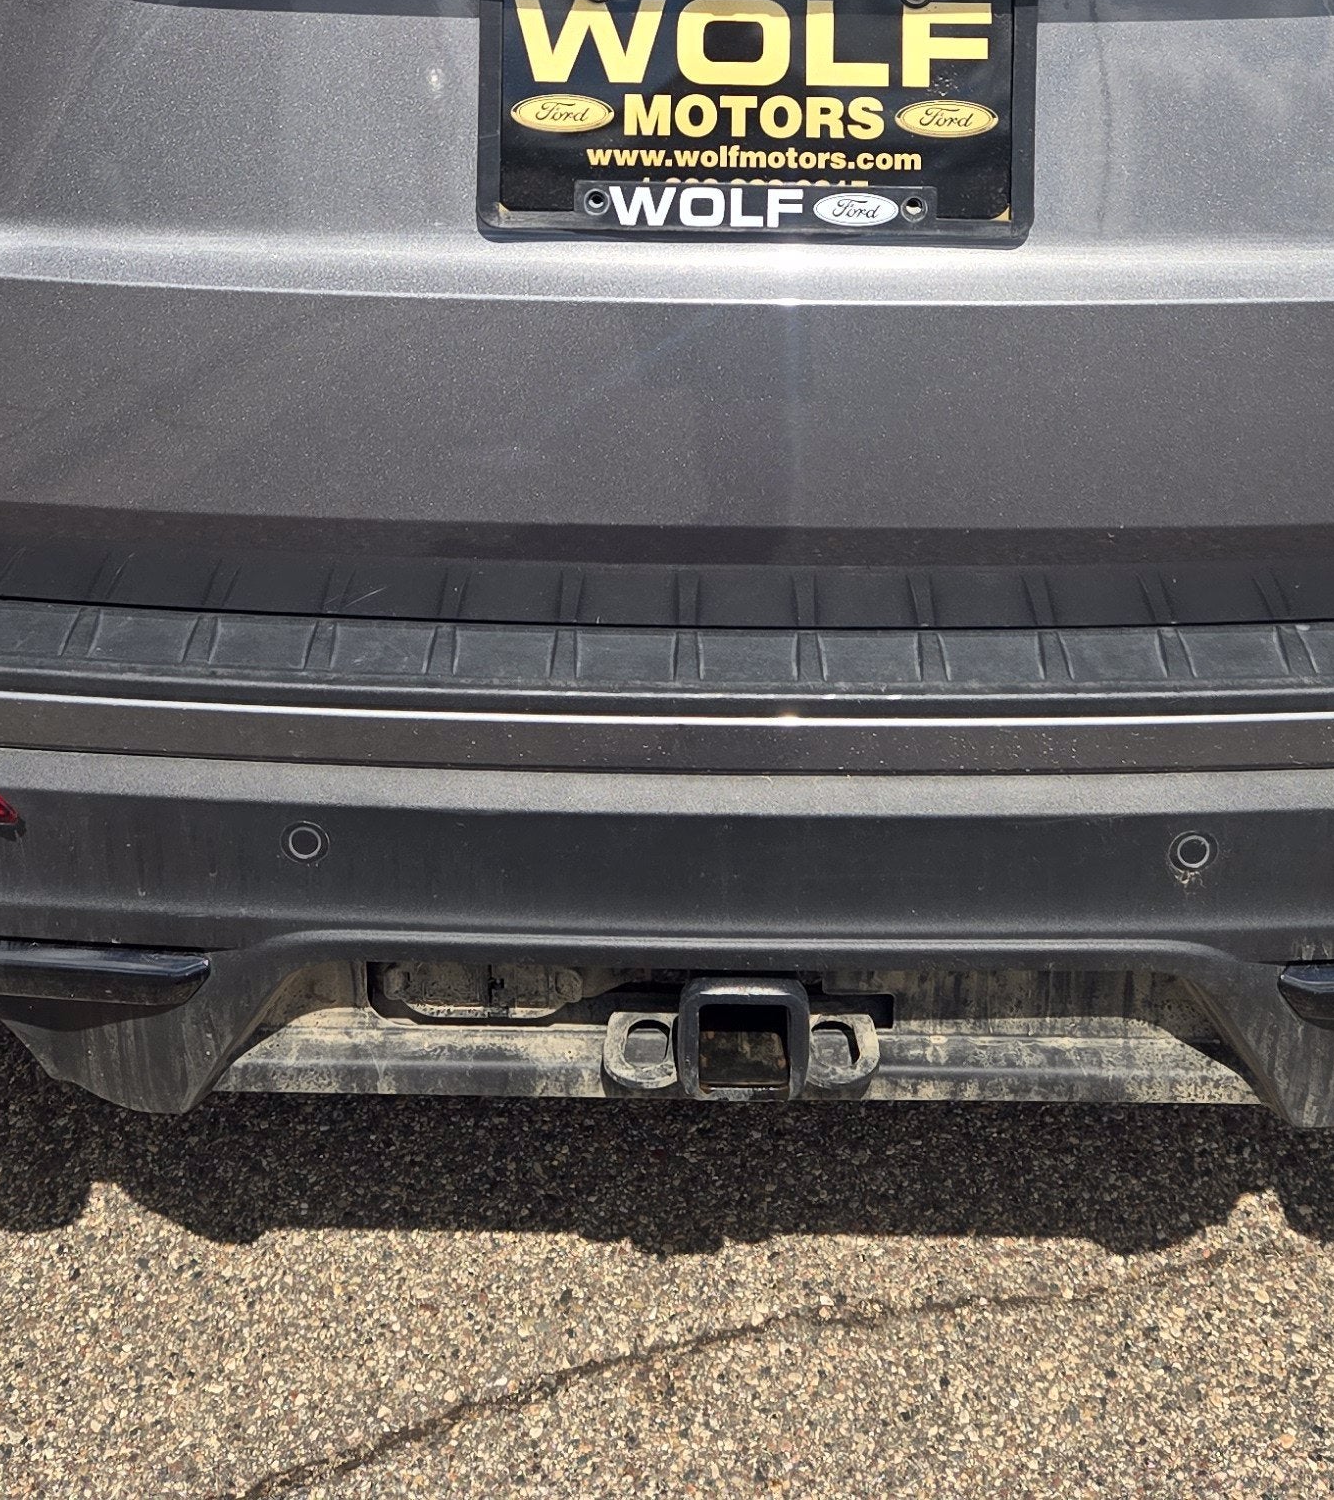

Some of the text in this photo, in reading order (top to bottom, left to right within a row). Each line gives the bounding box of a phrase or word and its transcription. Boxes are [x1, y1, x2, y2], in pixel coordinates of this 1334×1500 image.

[535, 101, 589, 122] Ford
[624, 93, 885, 140] MOTORS
[919, 107, 974, 128] Ford
[586, 145, 922, 171] www.wolfmotors.com
[608, 185, 881, 228] WOLF Ford
